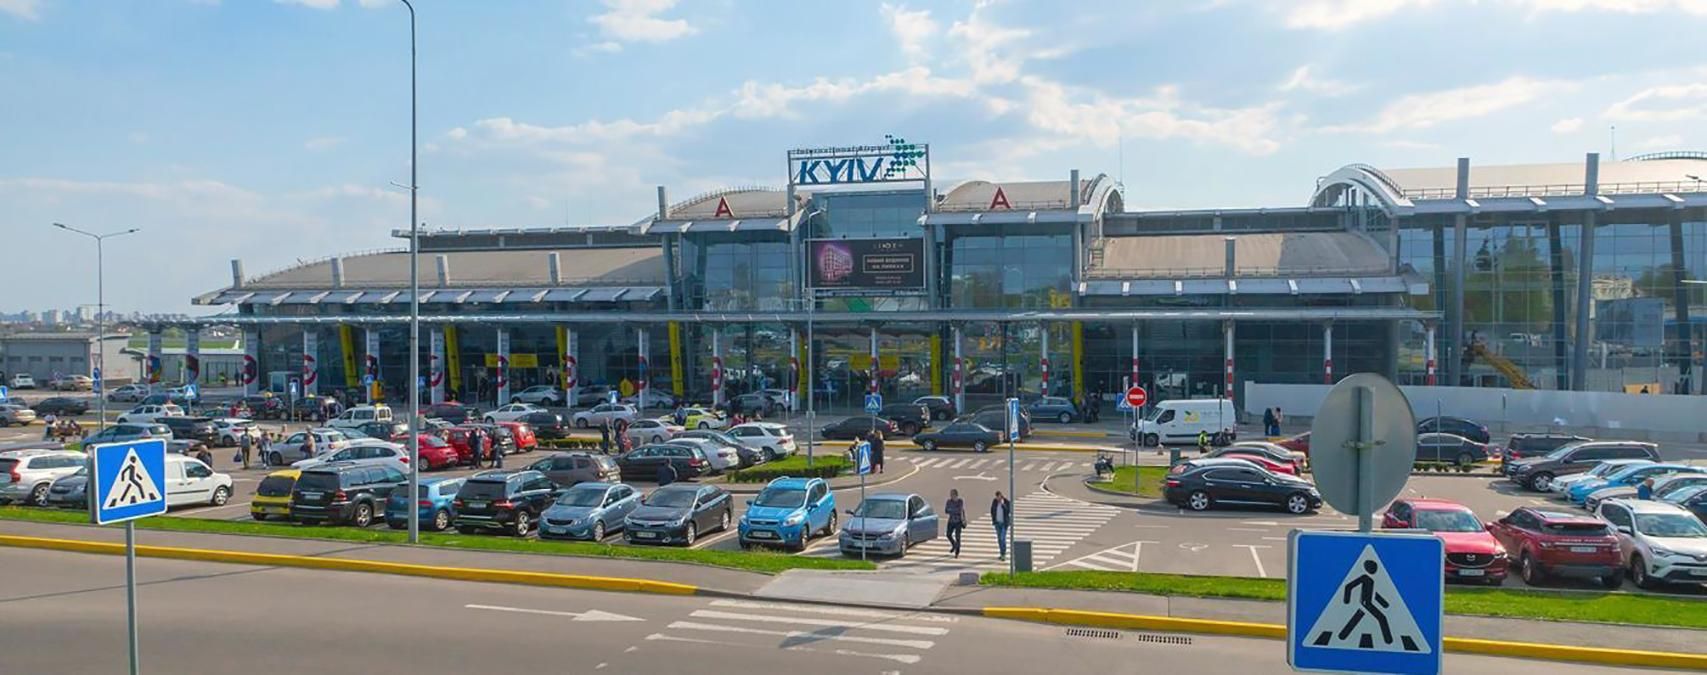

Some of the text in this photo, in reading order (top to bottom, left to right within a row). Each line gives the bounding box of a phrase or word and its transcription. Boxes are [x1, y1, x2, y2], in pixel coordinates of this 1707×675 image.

[799, 157, 884, 184] KYIV
[715, 197, 733, 217] A
[989, 186, 1012, 209] A
